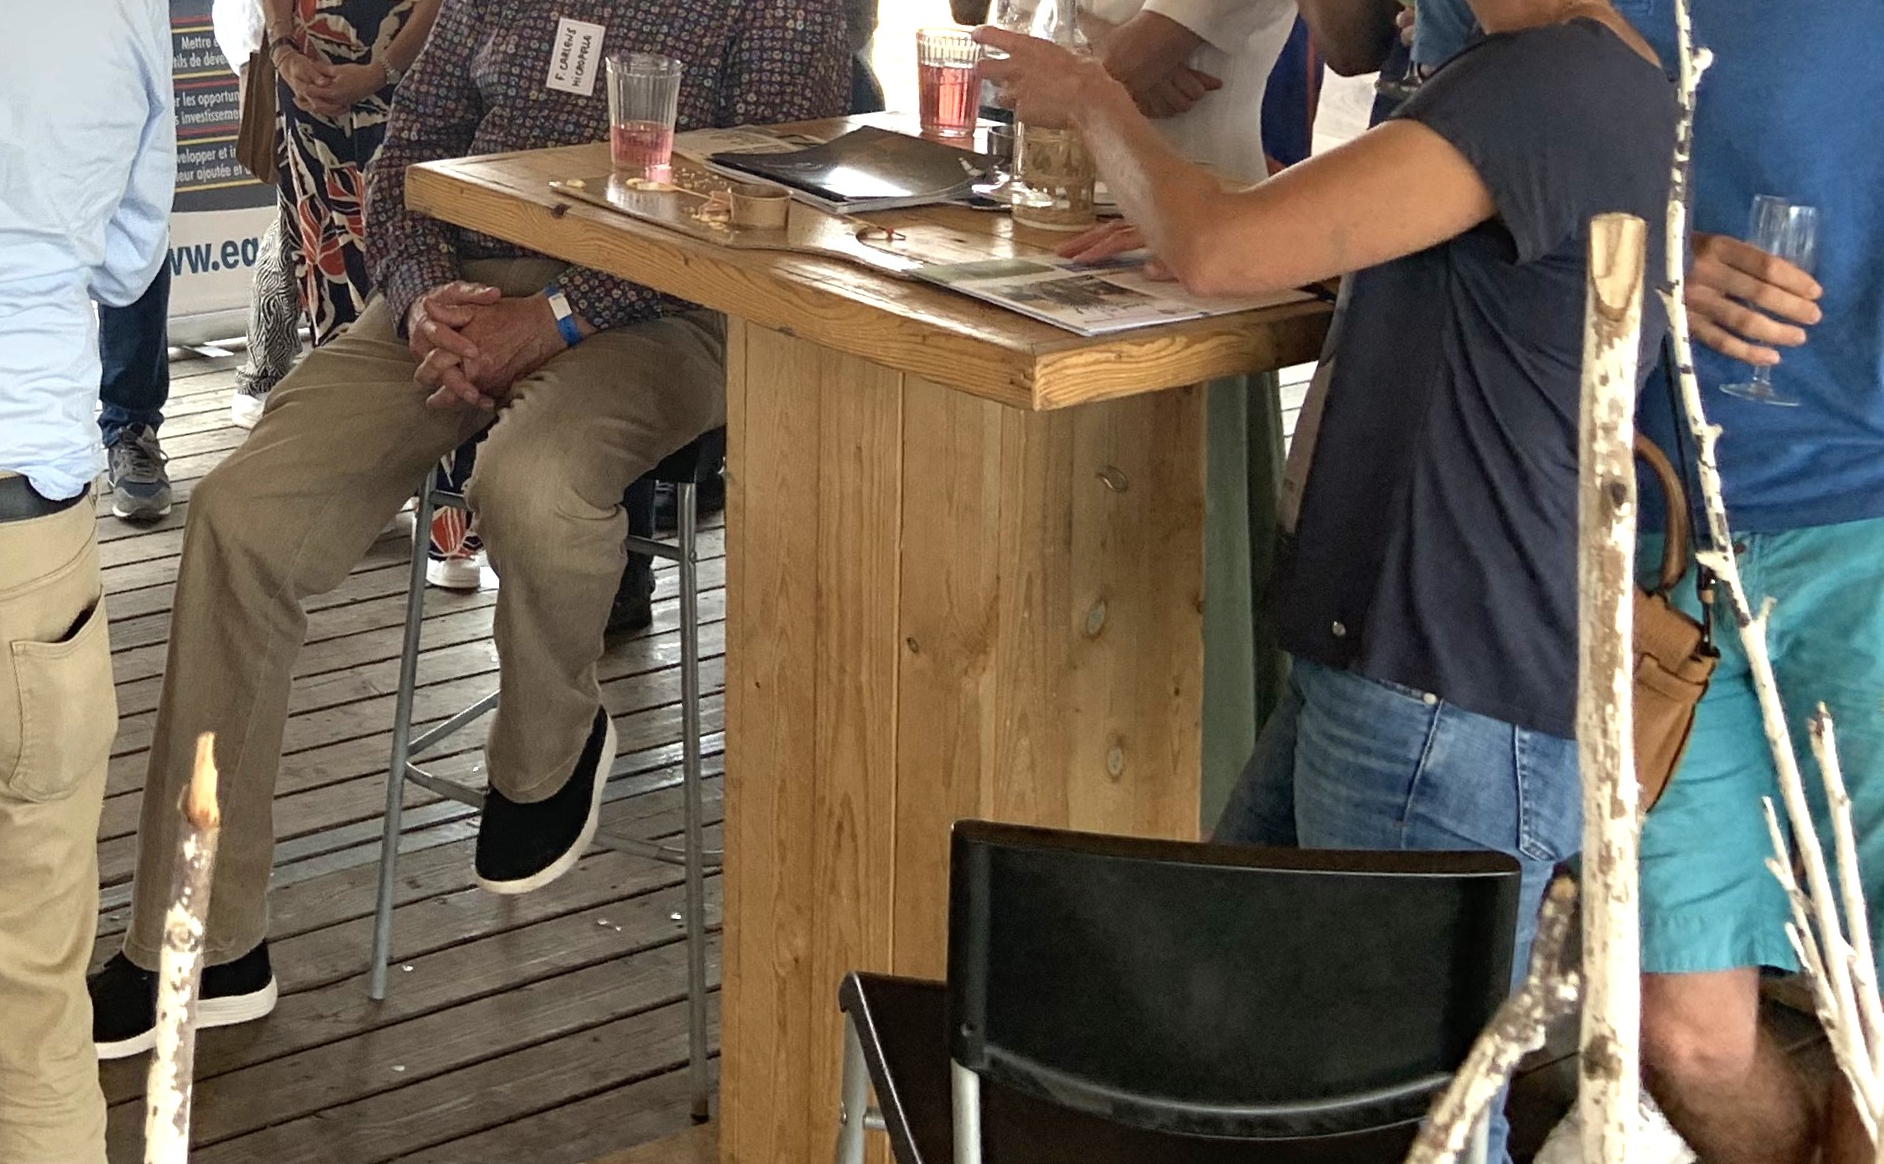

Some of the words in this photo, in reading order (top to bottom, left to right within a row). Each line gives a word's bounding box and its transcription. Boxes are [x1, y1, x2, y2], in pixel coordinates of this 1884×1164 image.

[181, 36, 212, 50] Mettre
[190, 52, 201, 67] de
[203, 51, 229, 66] déve
[182, 92, 196, 107] les
[218, 147, 228, 159] et
[197, 163, 231, 183] ajoutée
[233, 164, 243, 176] et
